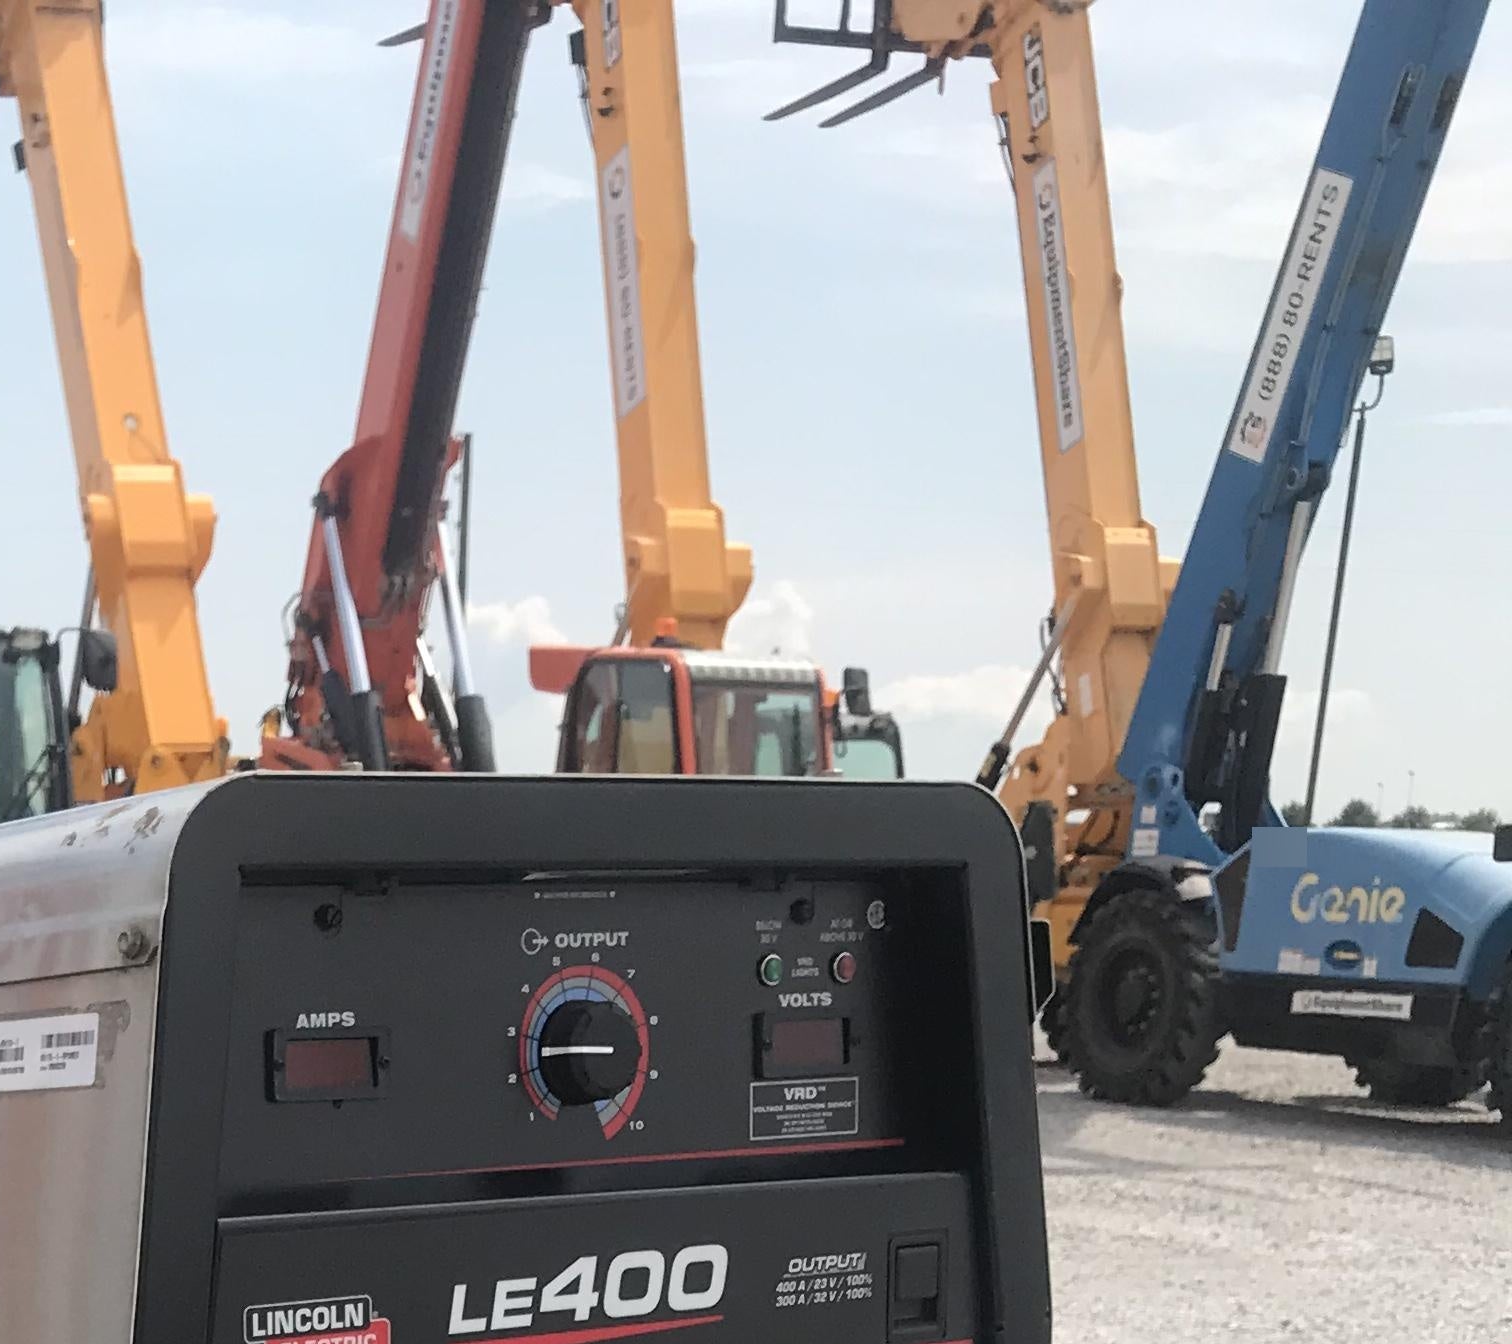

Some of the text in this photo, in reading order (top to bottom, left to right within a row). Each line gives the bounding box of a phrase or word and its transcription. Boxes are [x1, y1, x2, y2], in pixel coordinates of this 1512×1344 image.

[1259, 183, 1339, 401] (888) 80-RENTS
[1291, 872, 1406, 923] Genie
[554, 932, 629, 948] OUTPUT
[627, 969, 635, 978] 7
[520, 984, 530, 994] 4
[778, 992, 833, 1008] VOLTS
[295, 1011, 356, 1029] AMPS
[507, 1027, 516, 1037] 3
[508, 1074, 517, 1084] 2
[650, 1070, 659, 1080] 9
[530, 1112, 535, 1121] 1
[629, 1120, 644, 1131] 10
[448, 1244, 728, 1336] LE400
[776, 1281, 797, 1293] 400
[798, 1281, 806, 1291] A
[814, 1278, 828, 1290] 23
[829, 1277, 838, 1288] V
[846, 1274, 872, 1286] 100%
[776, 1295, 796, 1307] 300
[798, 1294, 806, 1304] A
[814, 1292, 827, 1303] 32
[829, 1291, 837, 1302] V
[846, 1288, 872, 1299] 100%
[252, 1303, 364, 1337] LINCOLN
